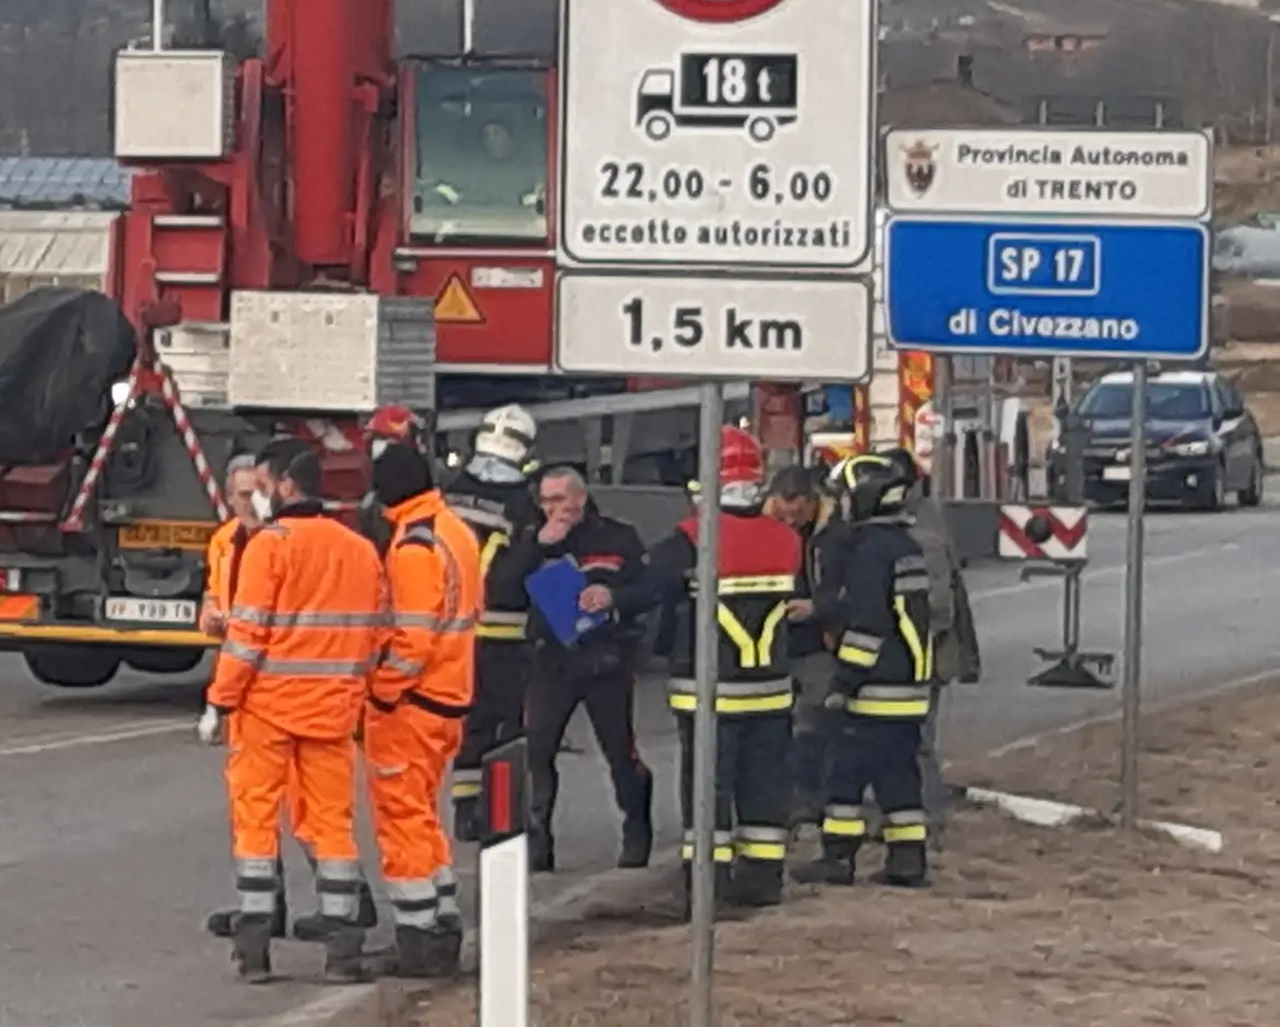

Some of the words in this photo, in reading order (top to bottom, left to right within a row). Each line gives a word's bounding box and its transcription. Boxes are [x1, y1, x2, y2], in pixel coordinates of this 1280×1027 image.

[703, 57, 748, 103] 18
[756, 66, 772, 102] t
[957, 144, 1062, 166] Provincia
[1070, 144, 1189, 167] Autonoma
[1006, 179, 1027, 199] di
[1035, 179, 1137, 201] TRENTO
[581, 219, 688, 245] eccetto
[696, 220, 852, 247] autorizzati
[1000, 246, 1040, 281] SP
[1054, 248, 1085, 282] 17
[622, 297, 704, 352] 1,5
[724, 307, 803, 350] km
[948, 307, 978, 335] di
[989, 307, 1139, 340] Civezzano
